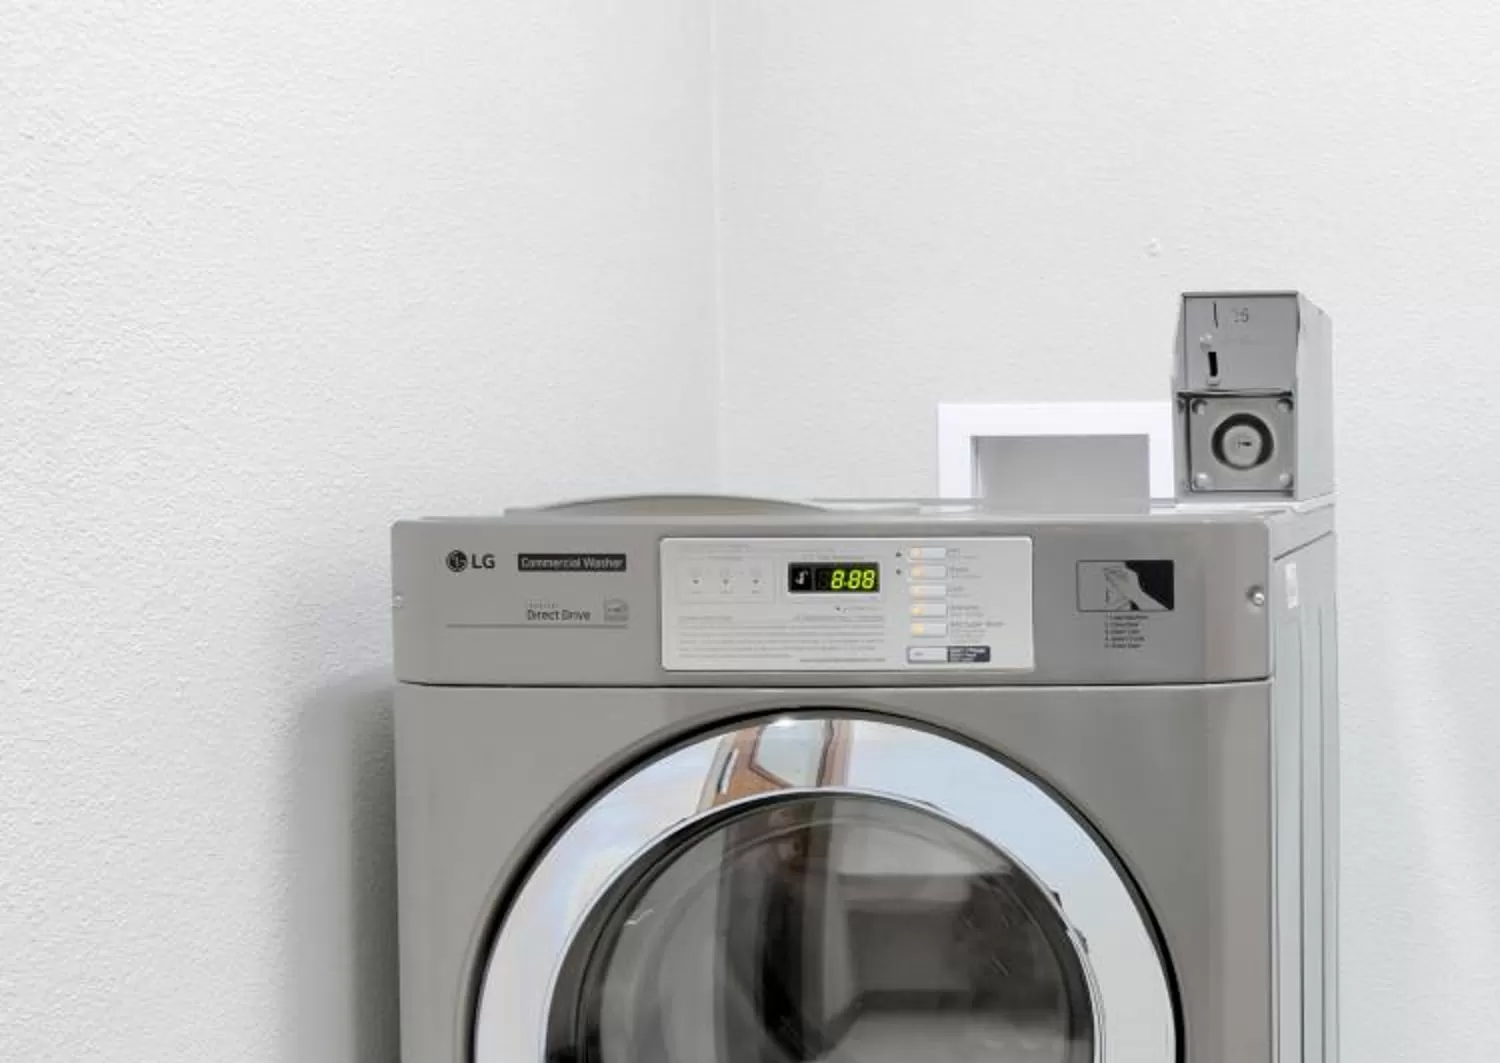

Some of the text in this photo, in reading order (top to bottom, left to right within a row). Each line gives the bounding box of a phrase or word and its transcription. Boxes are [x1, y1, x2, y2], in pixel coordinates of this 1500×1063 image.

[471, 554, 496, 570] LG
[520, 556, 624, 569] Commercial Washer
[526, 609, 560, 622] Direct
[561, 609, 592, 622] Drive
